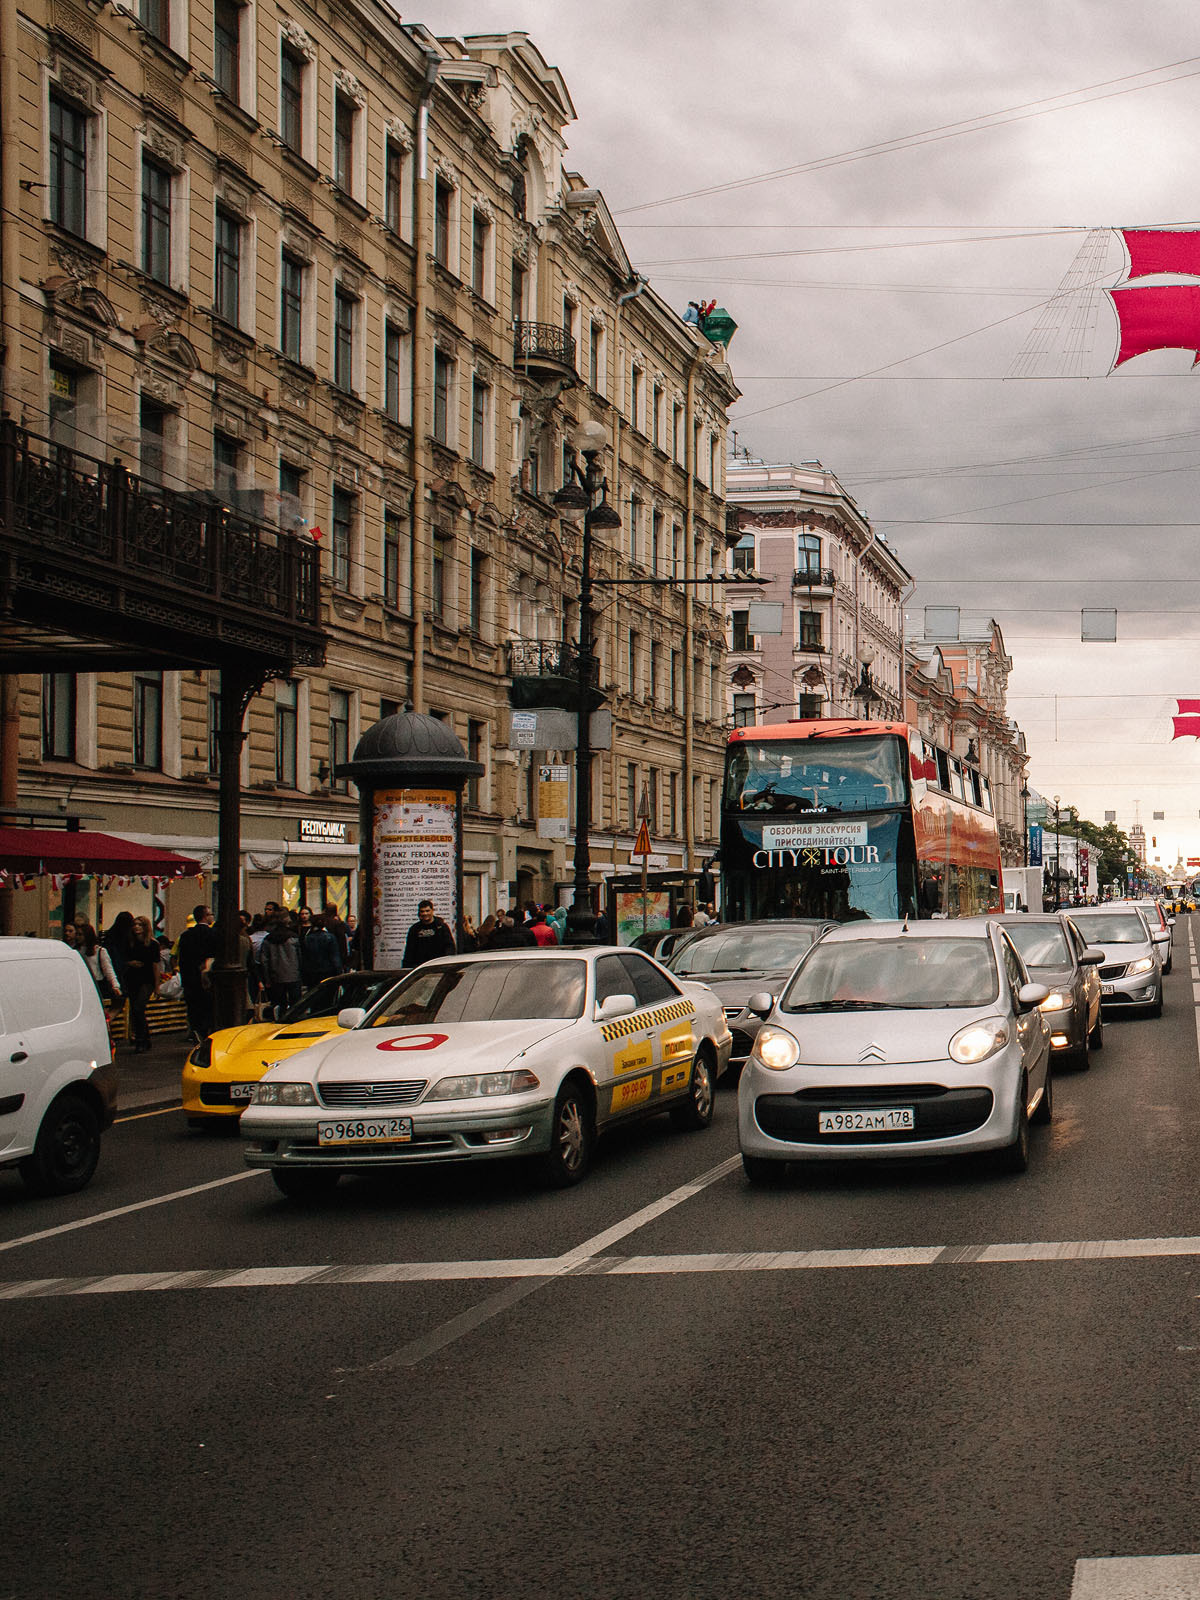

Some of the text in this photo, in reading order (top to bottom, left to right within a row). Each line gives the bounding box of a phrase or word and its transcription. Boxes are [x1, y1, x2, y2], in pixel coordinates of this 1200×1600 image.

[301, 819, 345, 837] РЕСПУБЛИКА
[770, 825, 862, 836] ОБЗОРНАЯ ЭКСКУРСИЯ
[775, 836, 856, 847] ПРИСОЕДИНЯЙТЕСЬ!
[752, 845, 880, 869] CITY TOUR
[820, 867, 881, 875] SAINT-PETERSBURG
[324, 1120, 406, 1139] О968ОХ 26
[825, 1111, 910, 1130] А982АМ 178
